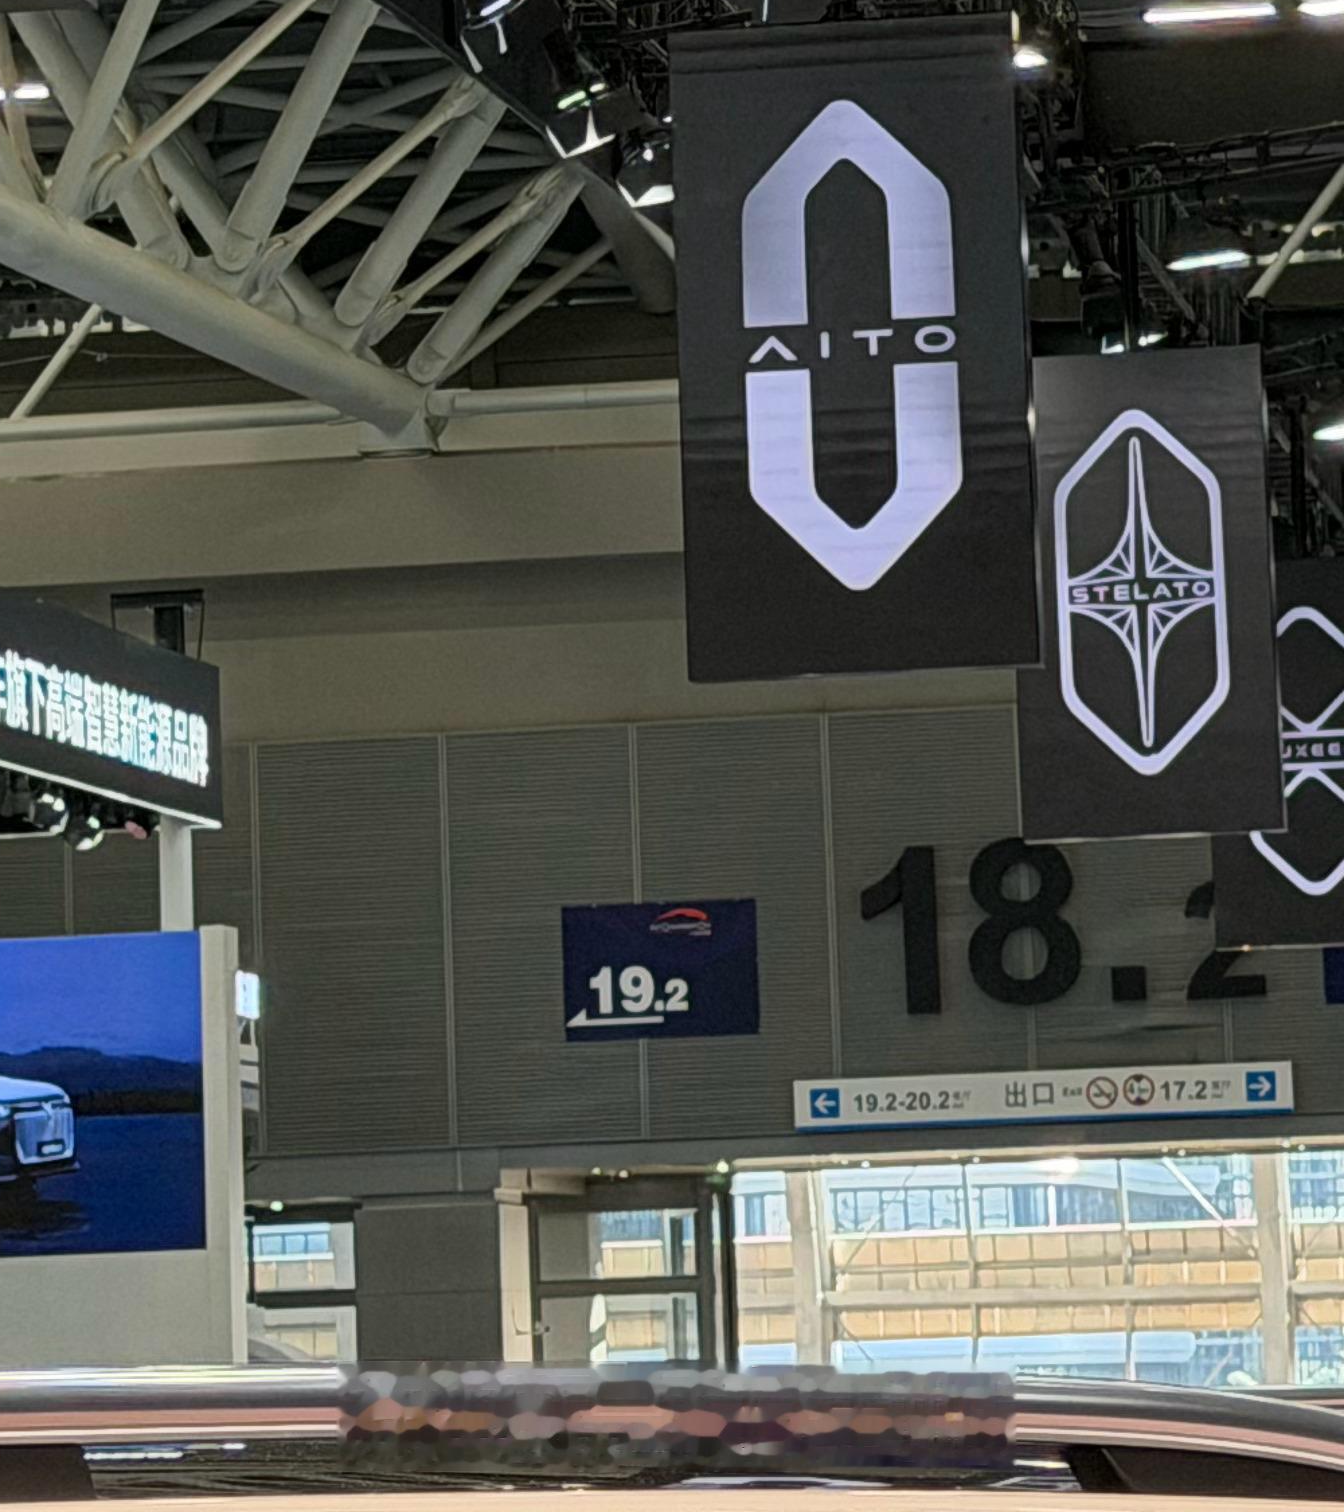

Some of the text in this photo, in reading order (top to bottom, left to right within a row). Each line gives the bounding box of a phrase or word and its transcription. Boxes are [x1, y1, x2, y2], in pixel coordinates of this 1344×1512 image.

[748, 324, 956, 364] AITO
[1071, 581, 1211, 603] STELATO
[589, 965, 690, 1015] 19.2
[854, 1090, 951, 1112] 19.2-20.2
[1004, 1080, 1055, 1109] 出口
[1159, 1080, 1208, 1102] 17.2
